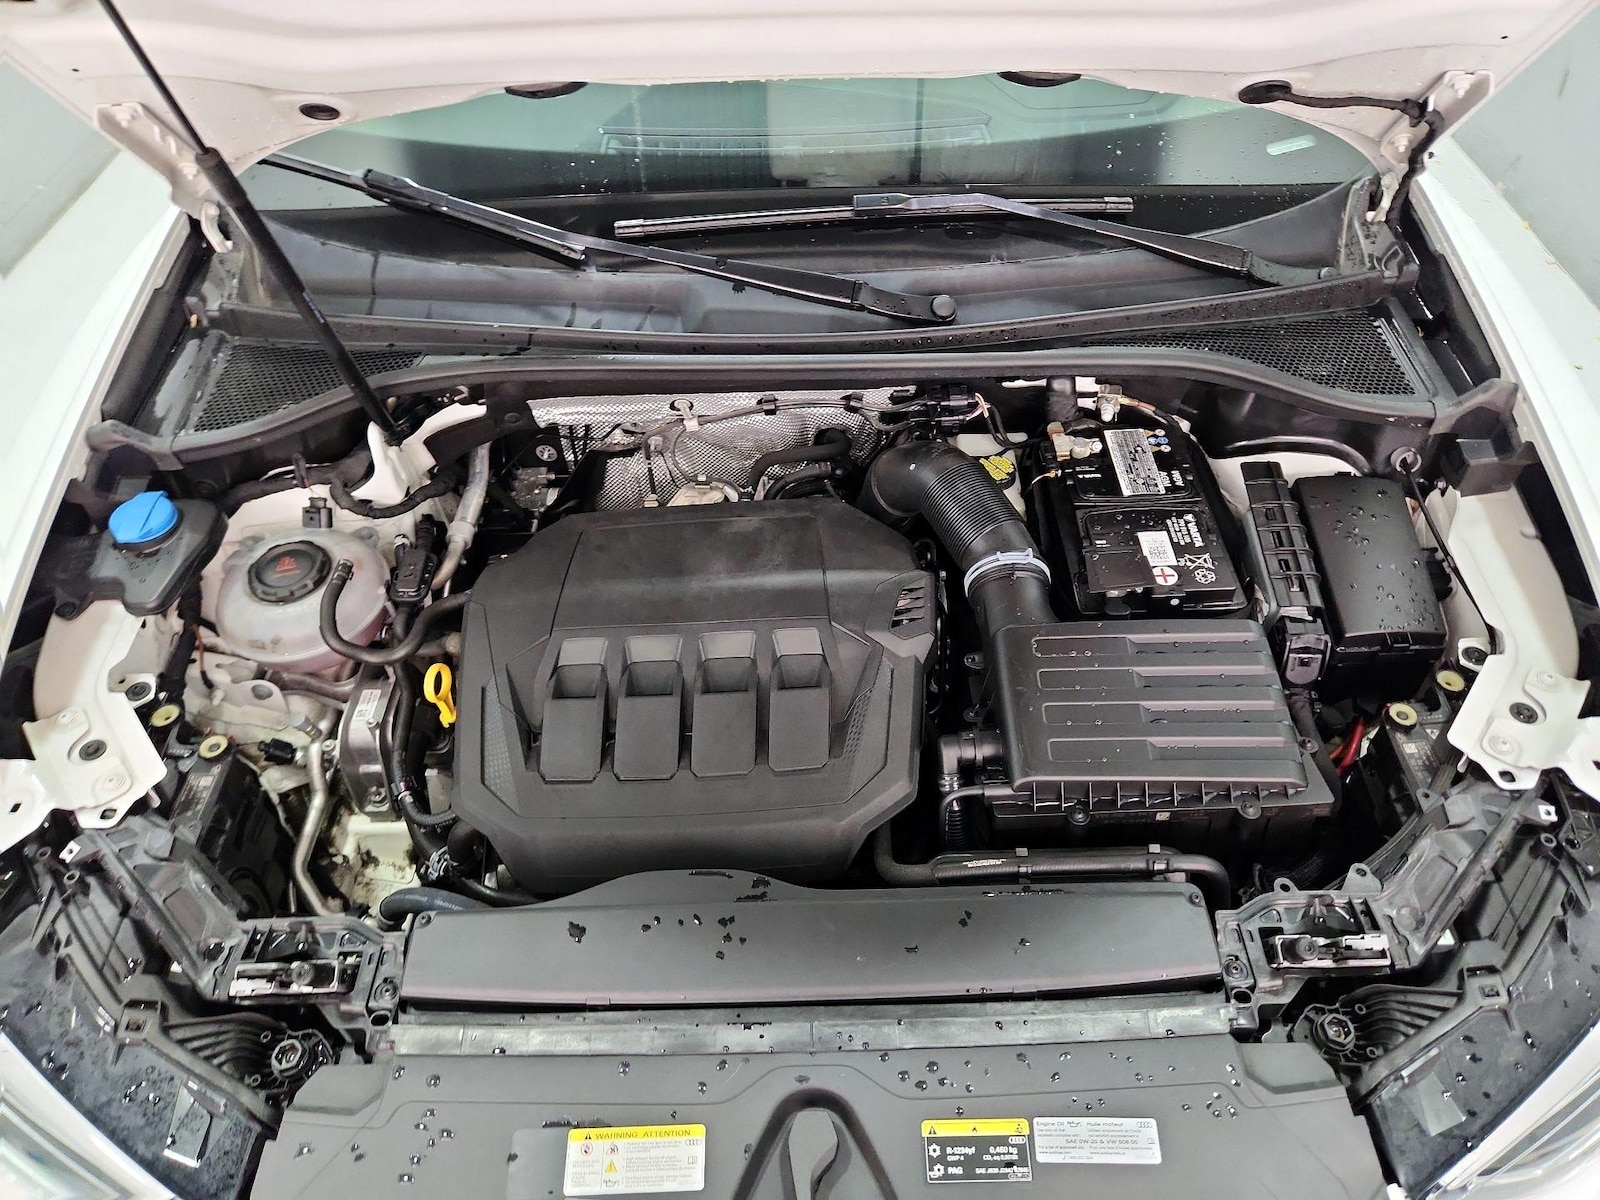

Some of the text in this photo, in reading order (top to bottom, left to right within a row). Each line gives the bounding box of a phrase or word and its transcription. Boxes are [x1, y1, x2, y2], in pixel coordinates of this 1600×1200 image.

[1187, 521, 1205, 548] VARTA
[595, 1129, 691, 1141] WARNING ATTENTION
[946, 1146, 976, 1156] R-1234yf
[1009, 1146, 1018, 1155] kg
[947, 1166, 964, 1174] PAG
